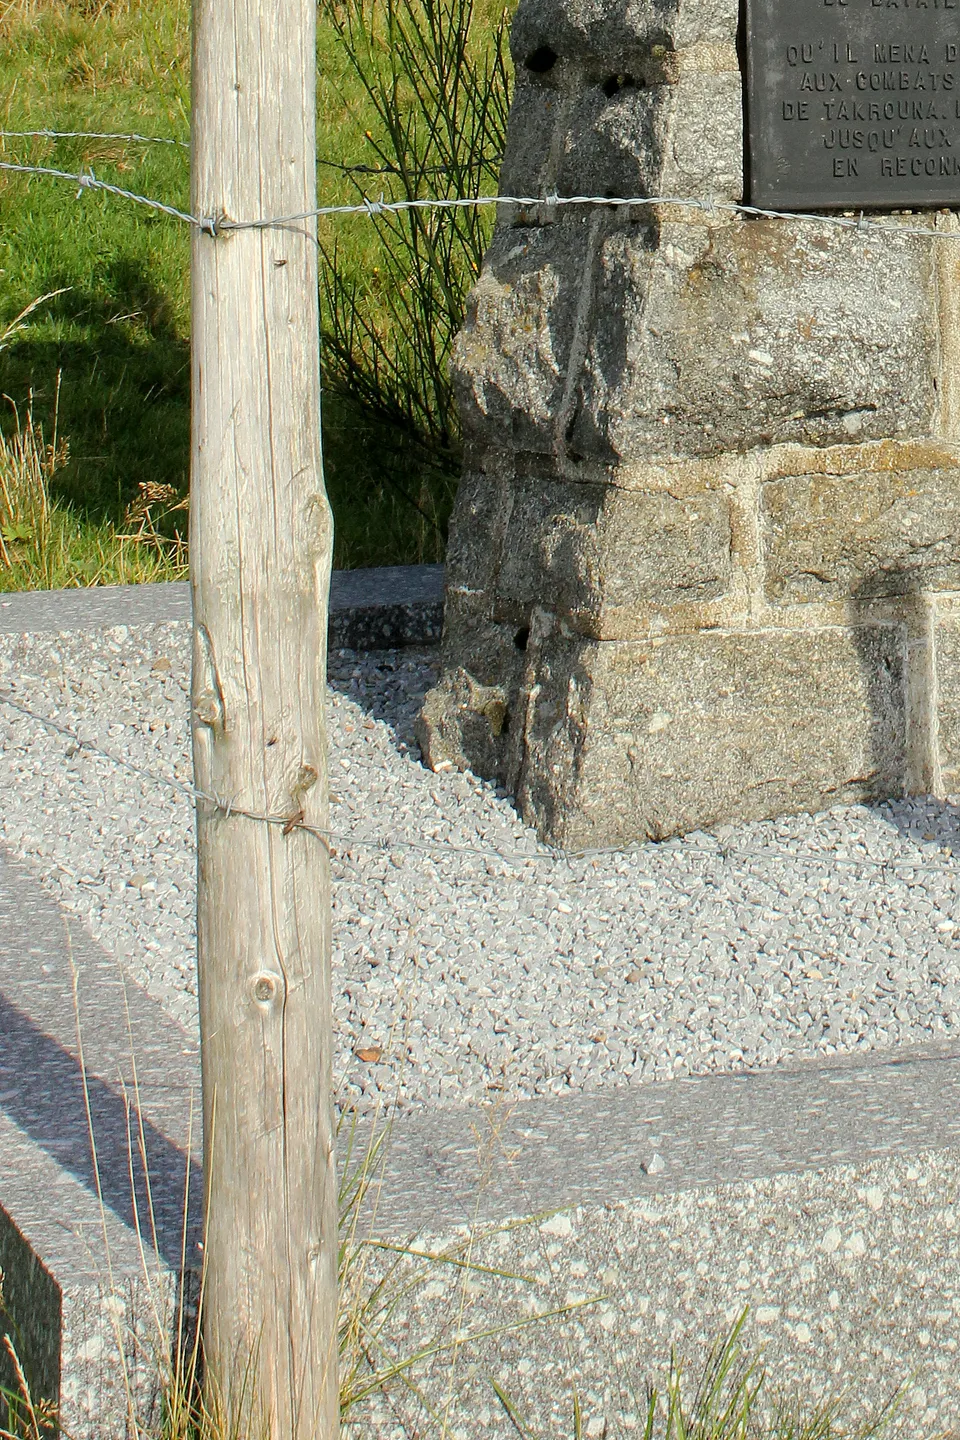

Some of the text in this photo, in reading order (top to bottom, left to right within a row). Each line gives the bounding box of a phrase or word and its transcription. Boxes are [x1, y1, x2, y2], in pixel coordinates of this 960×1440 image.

[786, 41, 859, 67] QU'IL
[874, 43, 930, 65] MENA
[800, 71, 842, 92] AUX
[855, 71, 954, 92] COMBATS
[781, 100, 809, 121] DE
[832, 157, 859, 178] EN
